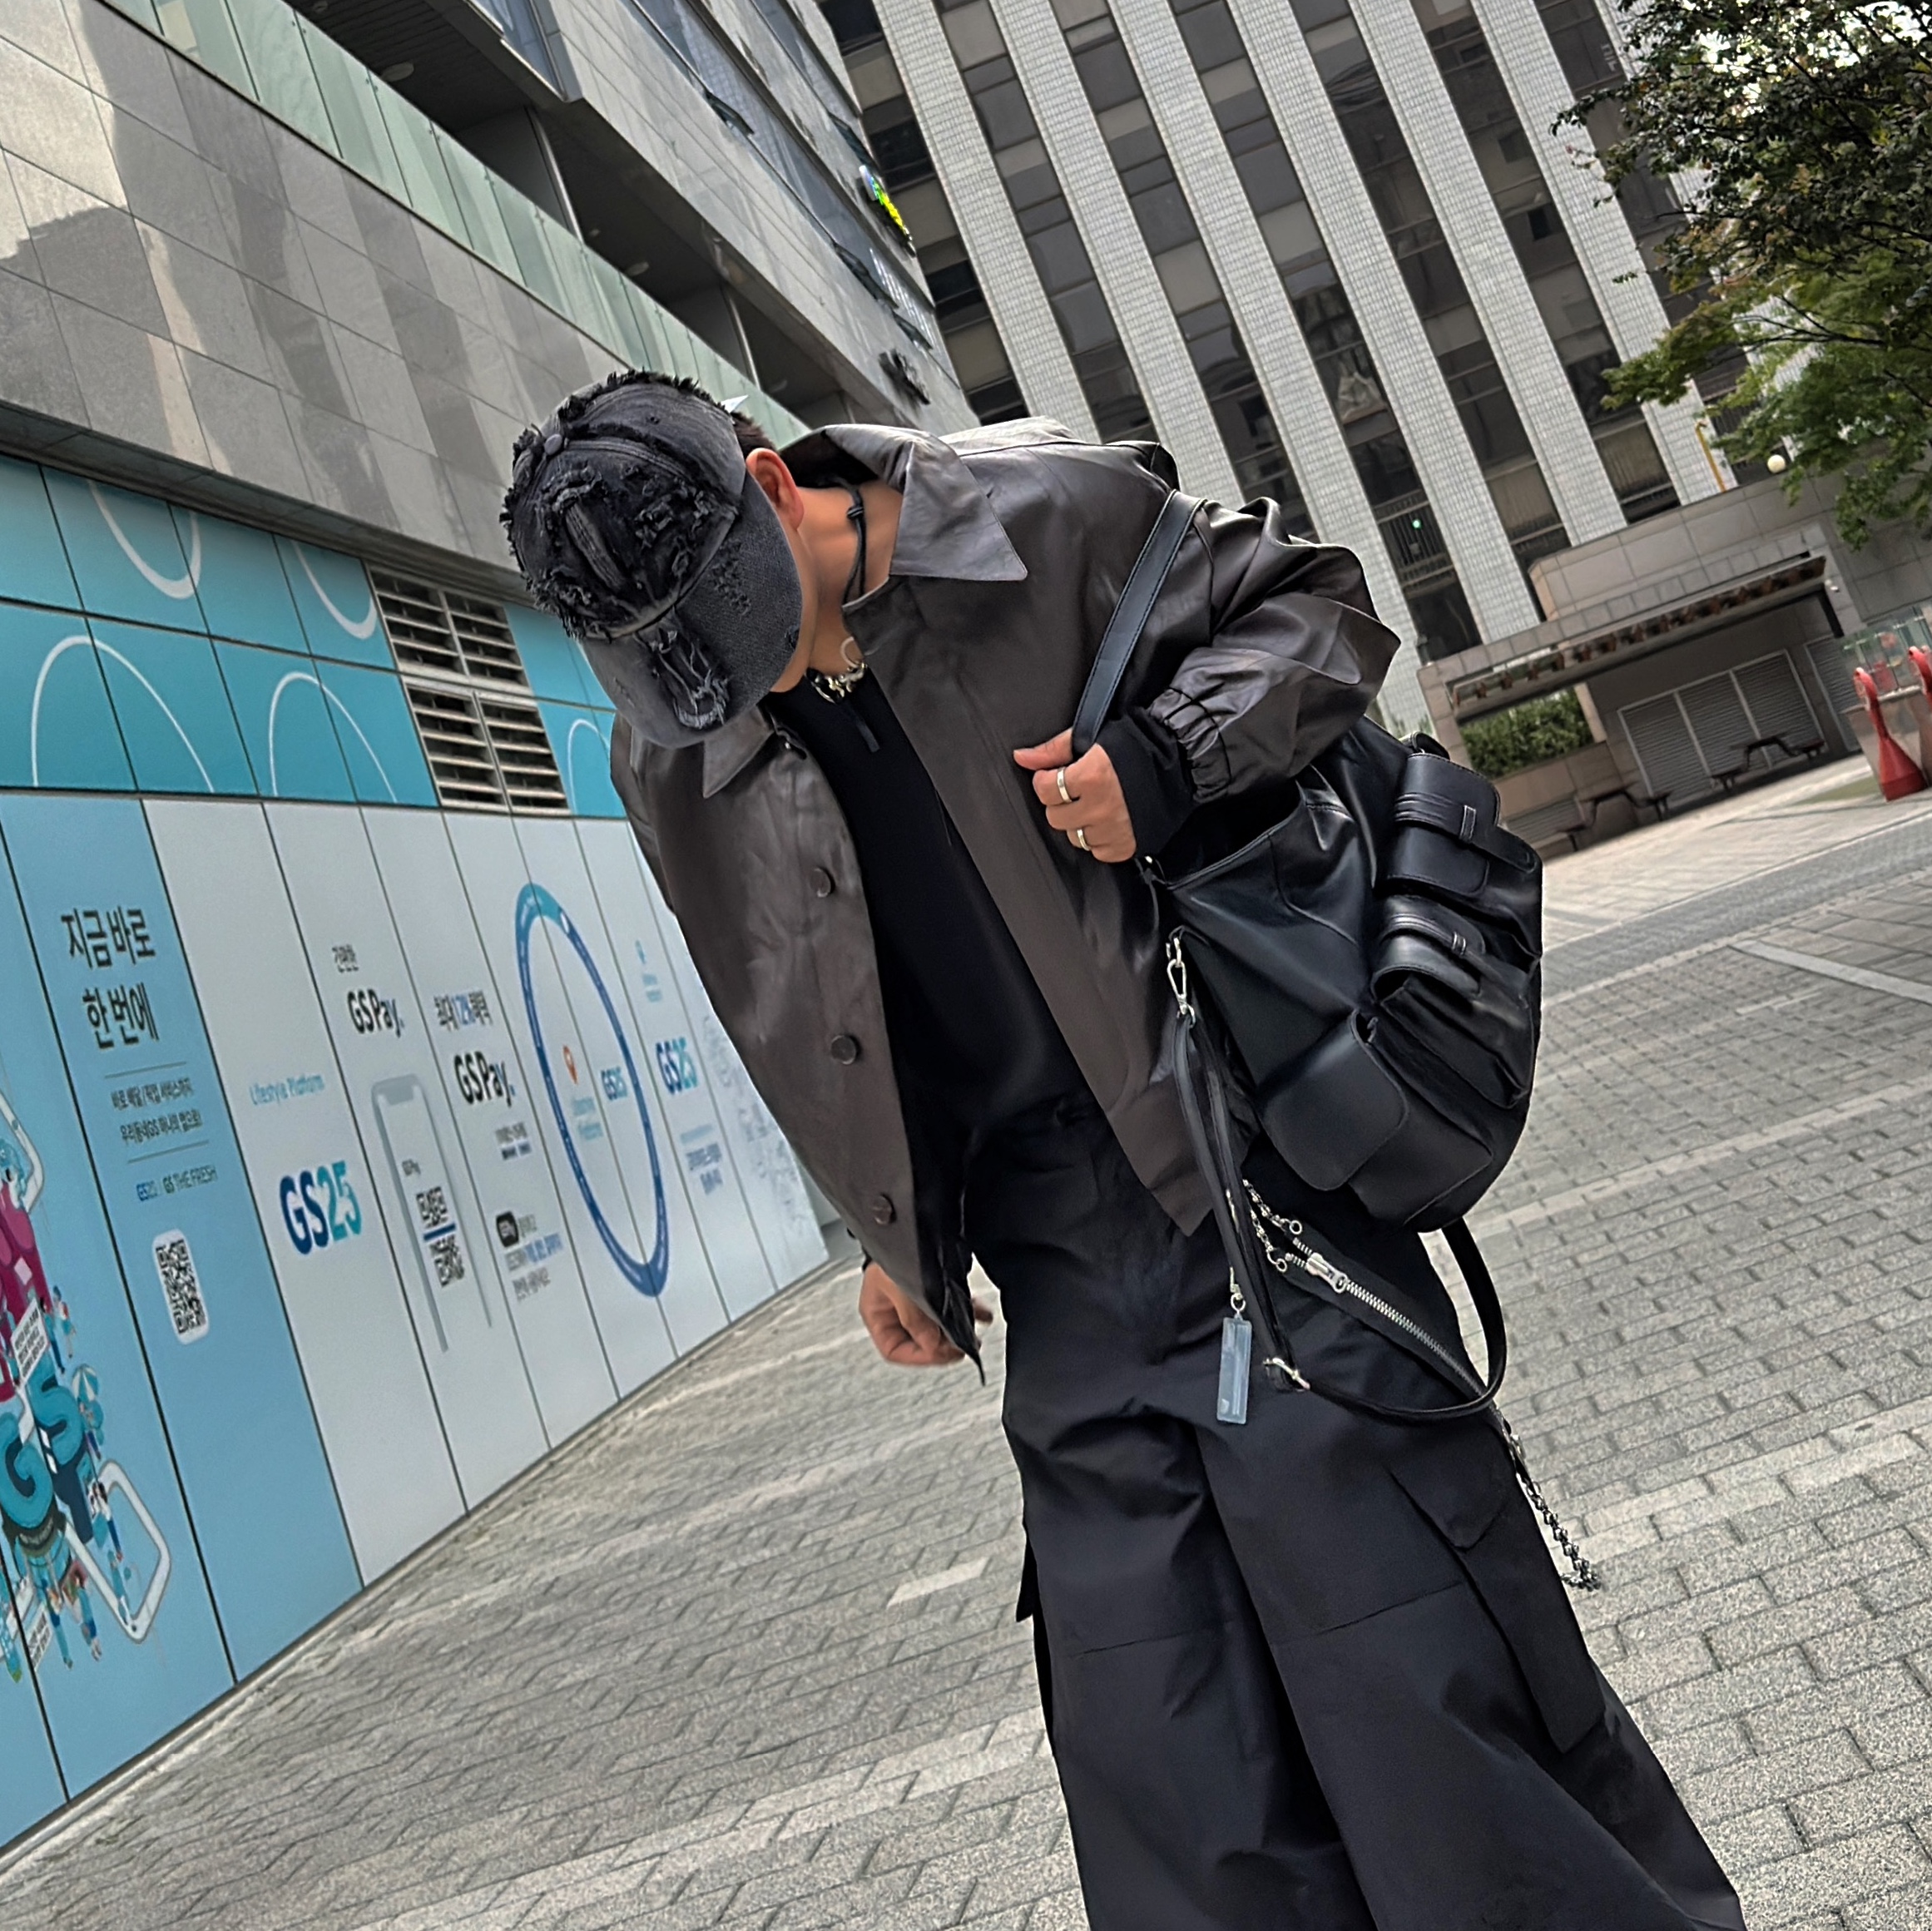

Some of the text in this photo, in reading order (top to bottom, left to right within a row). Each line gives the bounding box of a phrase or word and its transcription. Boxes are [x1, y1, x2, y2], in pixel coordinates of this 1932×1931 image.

[61, 905, 156, 969] 지금 바로
[601, 1067, 628, 1101] GS25
[656, 1037, 698, 1096] GS25
[280, 1161, 361, 1255] GS25
